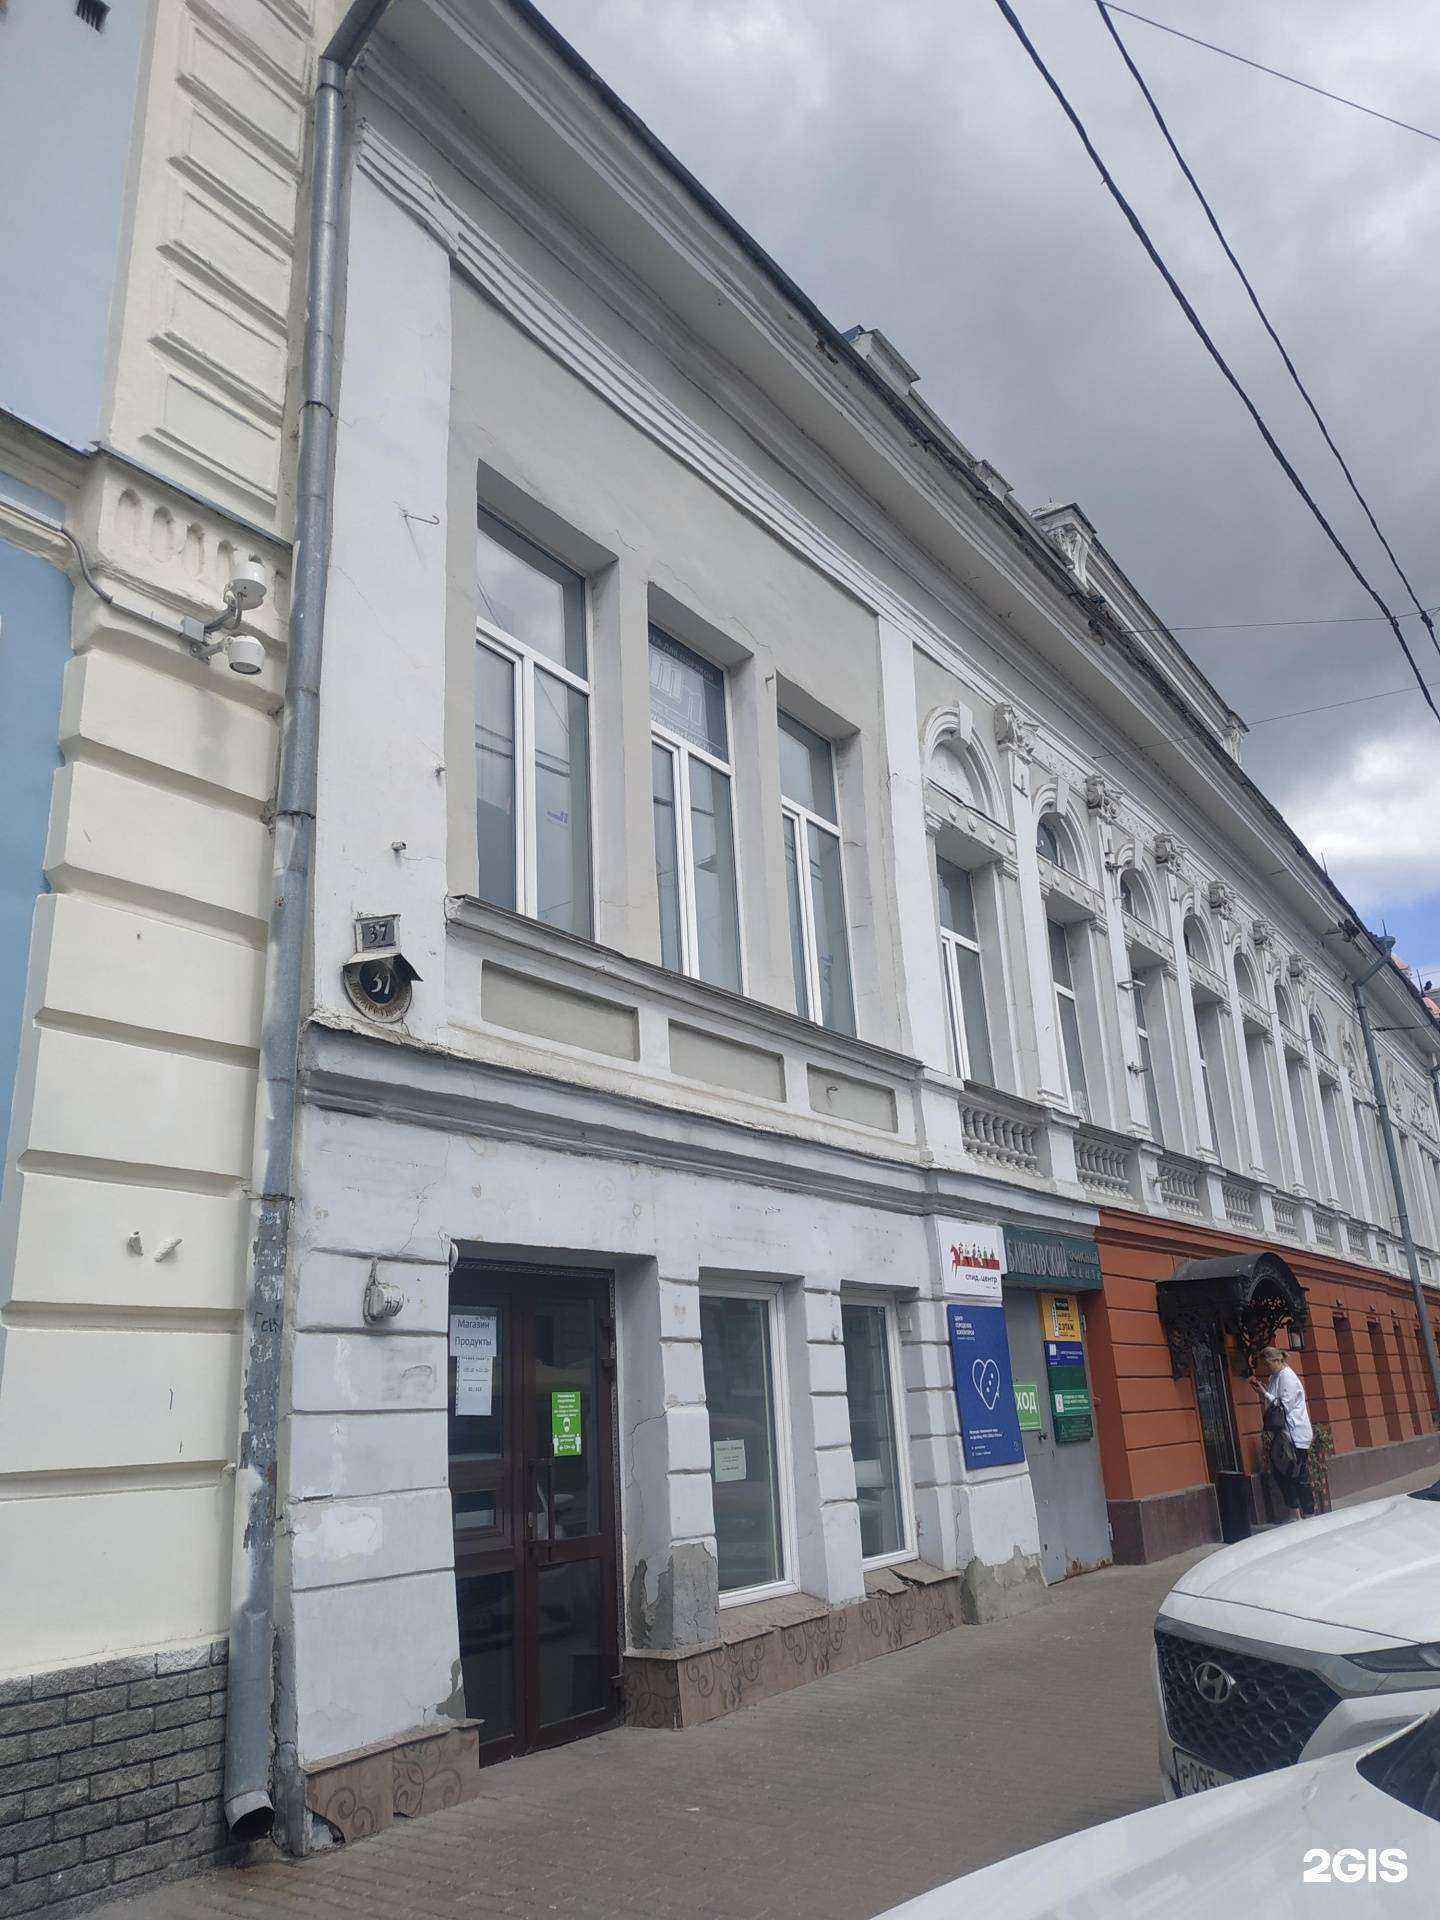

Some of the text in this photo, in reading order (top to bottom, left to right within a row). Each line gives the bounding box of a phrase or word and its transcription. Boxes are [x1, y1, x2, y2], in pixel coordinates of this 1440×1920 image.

[368, 923, 386, 943] 37
[457, 1318, 490, 1330] Магазин
[455, 1336, 492, 1348] Продукты
[1014, 1391, 1038, 1414] ХОД
